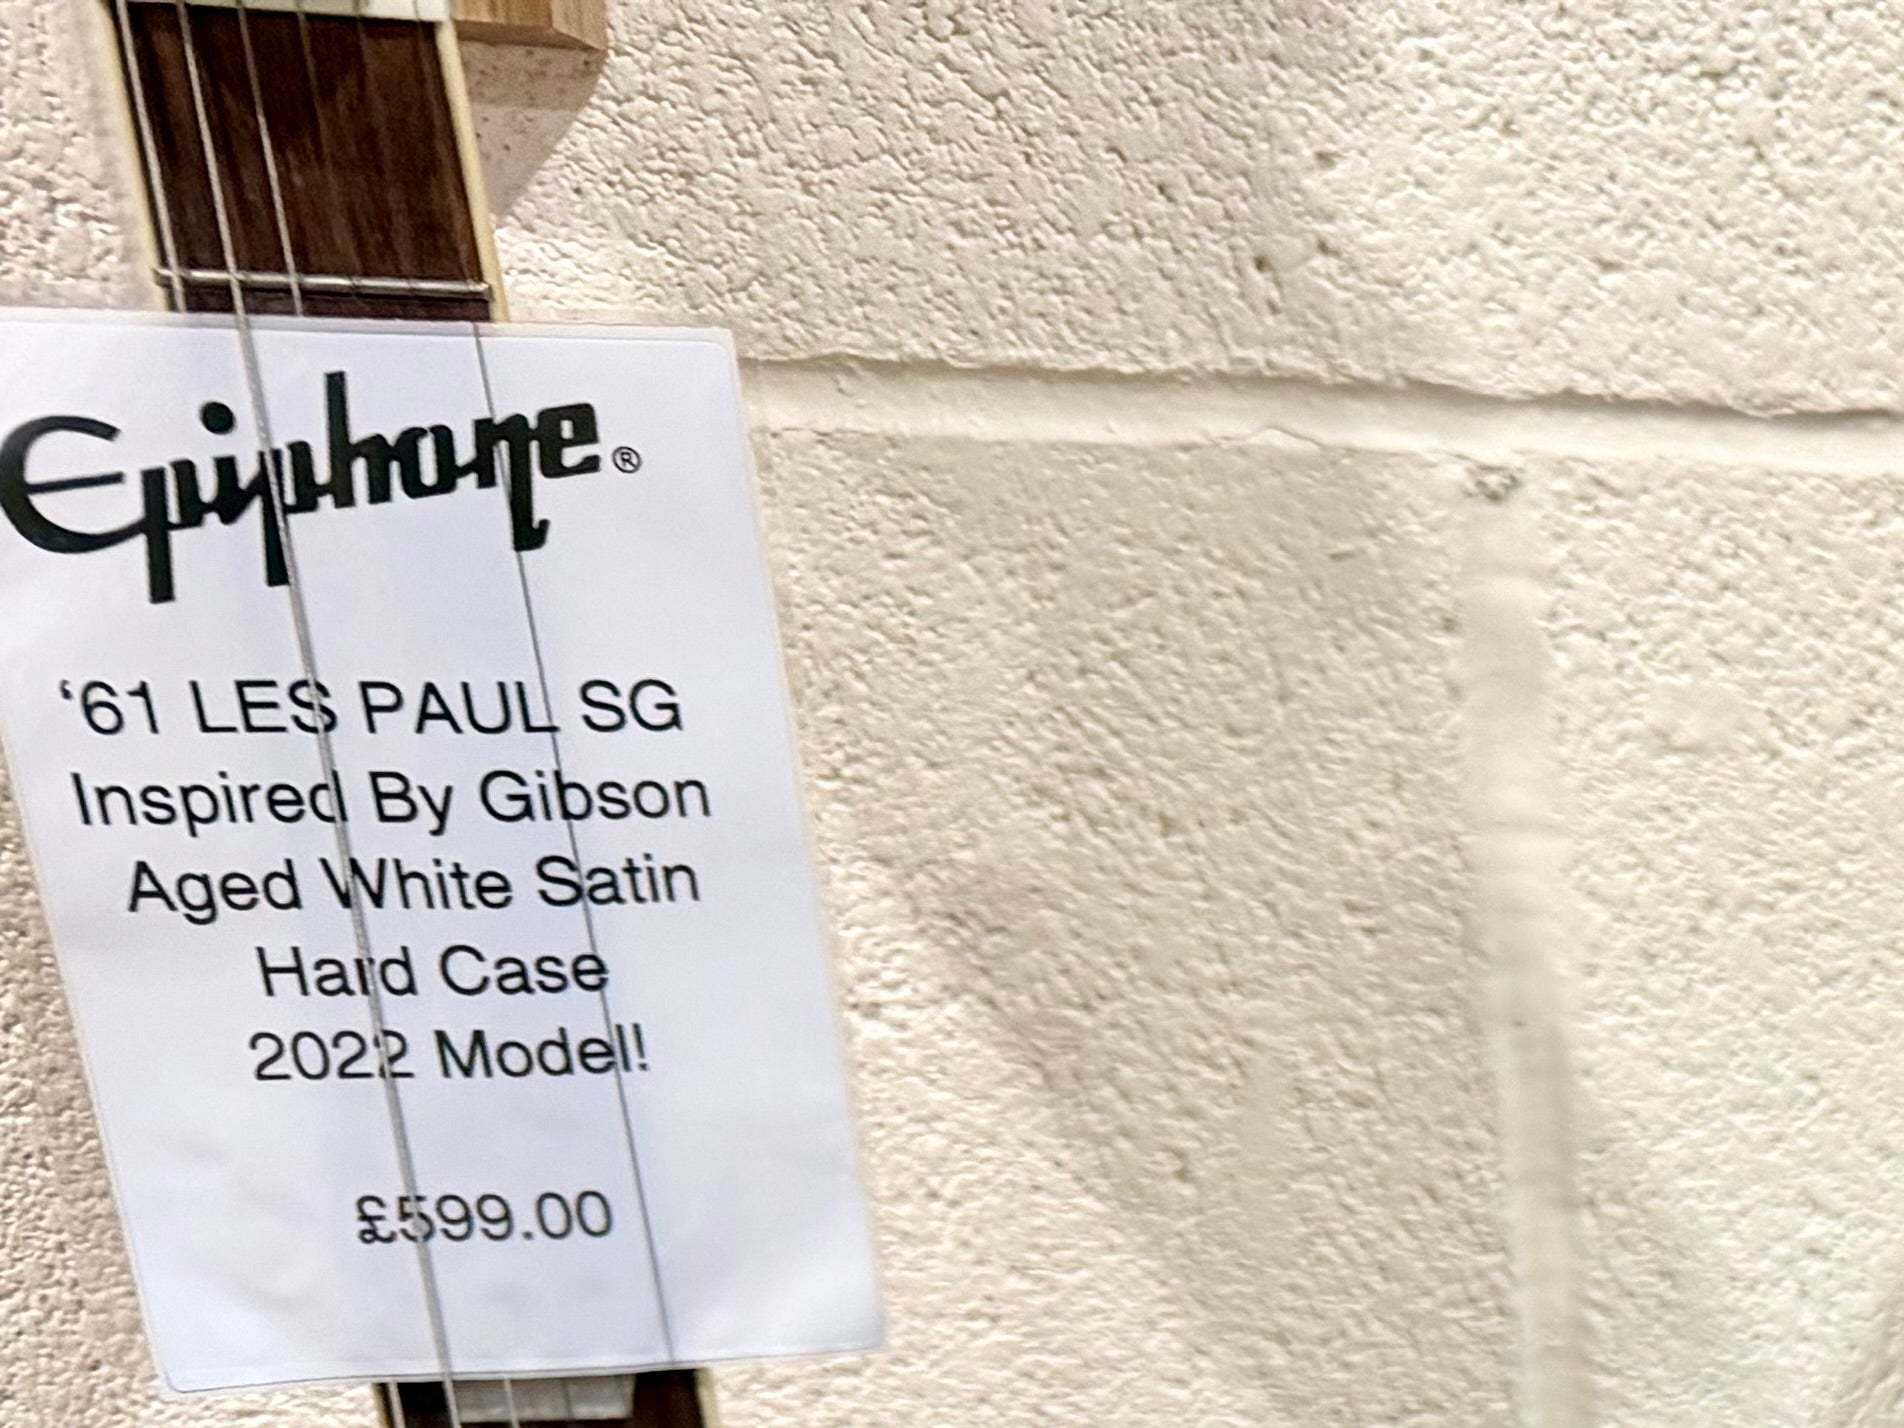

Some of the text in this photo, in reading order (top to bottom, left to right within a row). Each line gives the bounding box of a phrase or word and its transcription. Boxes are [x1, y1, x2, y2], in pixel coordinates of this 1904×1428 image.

[0, 370, 603, 604] Epiphone
[191, 681, 337, 735] LES
[362, 680, 557, 733] PAUL
[581, 679, 683, 732] SG
[72, 771, 711, 835] Inspired By Gibson
[128, 854, 700, 924] Aged White Satin
[258, 947, 609, 998] Hard Case
[251, 1024, 650, 1081] 2022 Model!
[357, 1191, 613, 1245] £599.00
